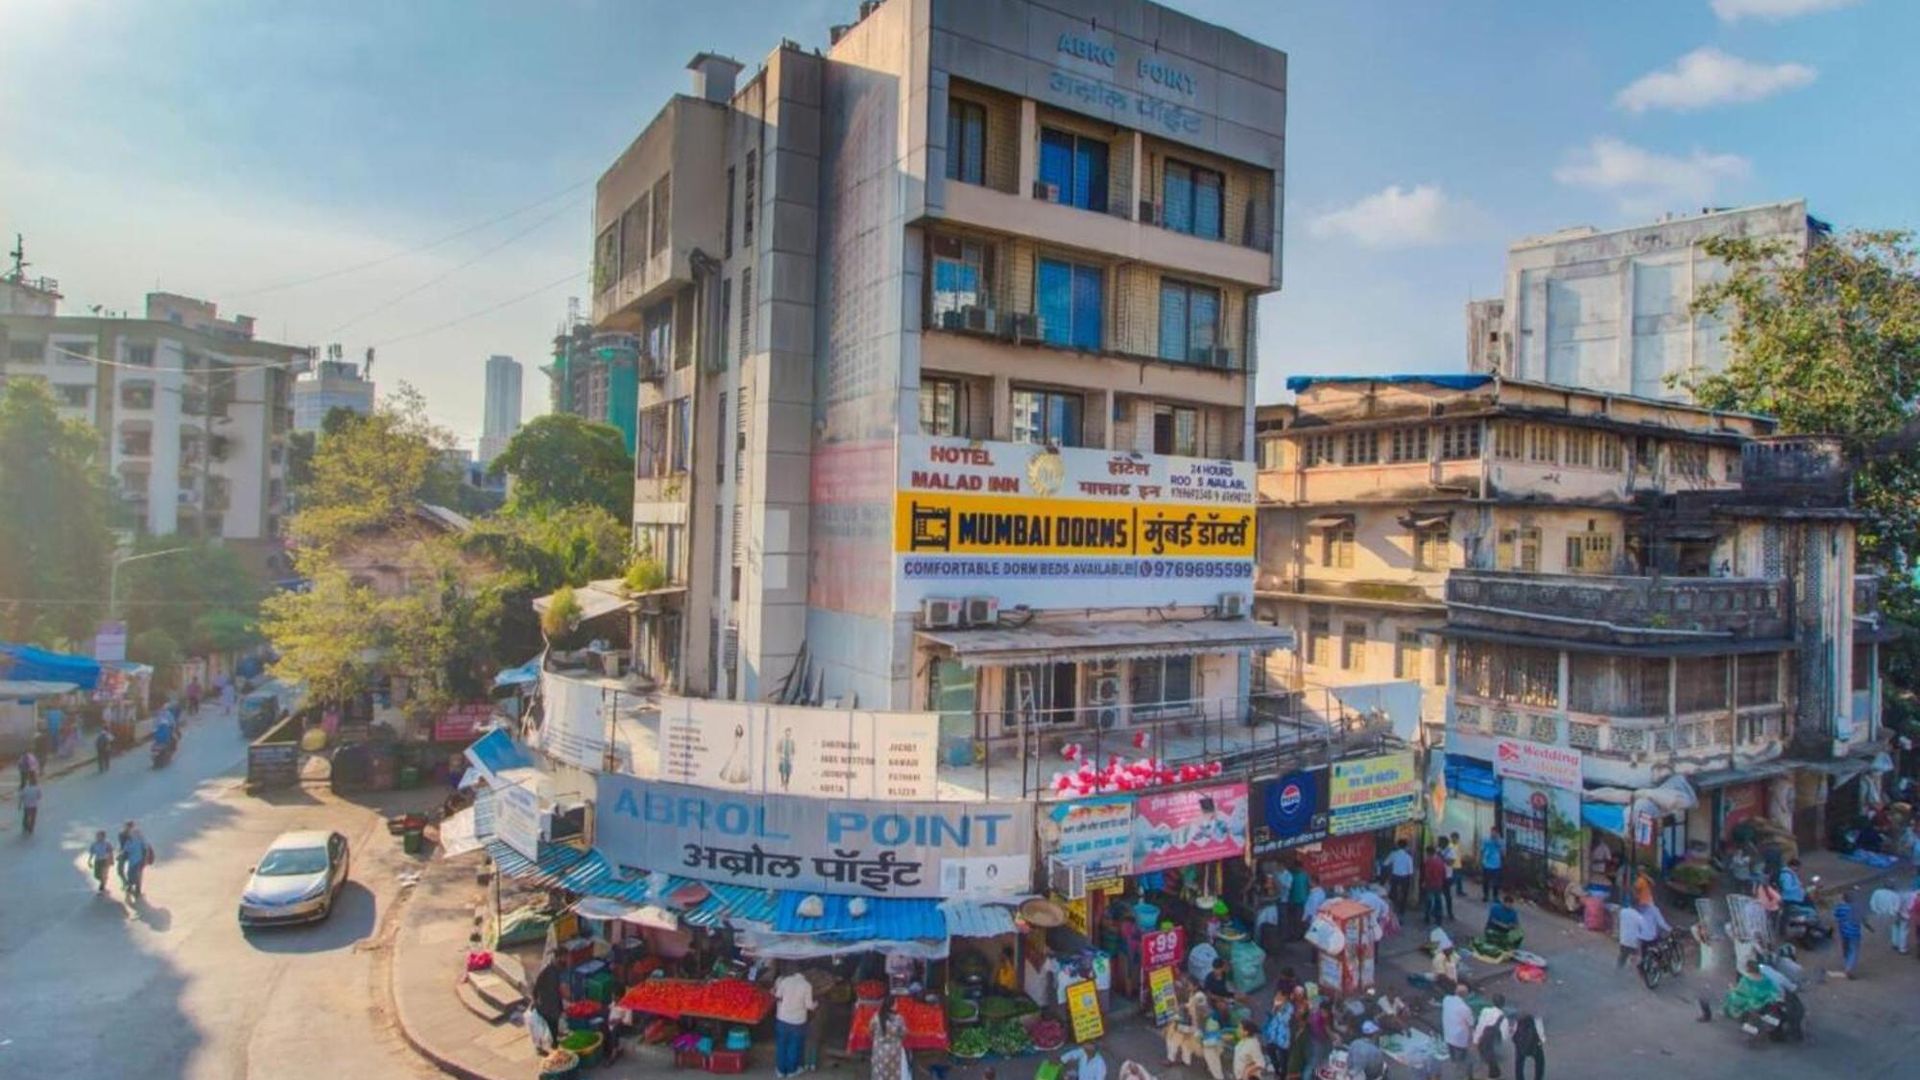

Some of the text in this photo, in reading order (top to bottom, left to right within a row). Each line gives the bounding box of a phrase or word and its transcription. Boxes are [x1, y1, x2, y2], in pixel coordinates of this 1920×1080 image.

[1137, 57, 1196, 97] POINT
[930, 445, 994, 466] HOTEL
[1203, 463, 1234, 477] HOURS
[911, 470, 1019, 492] MALAD INN
[958, 512, 1127, 548] MUMBAI DORMS
[1144, 512, 1197, 554] मुंबई
[904, 561, 1251, 578] COMFORTABLE DORM BEDS AVAILABLE 9769695599
[1524, 743, 1579, 767] Wedding
[613, 787, 790, 839] ABROL
[827, 812, 1012, 847] POINT
[683, 843, 922, 892] अब्रोल पॉईंट
